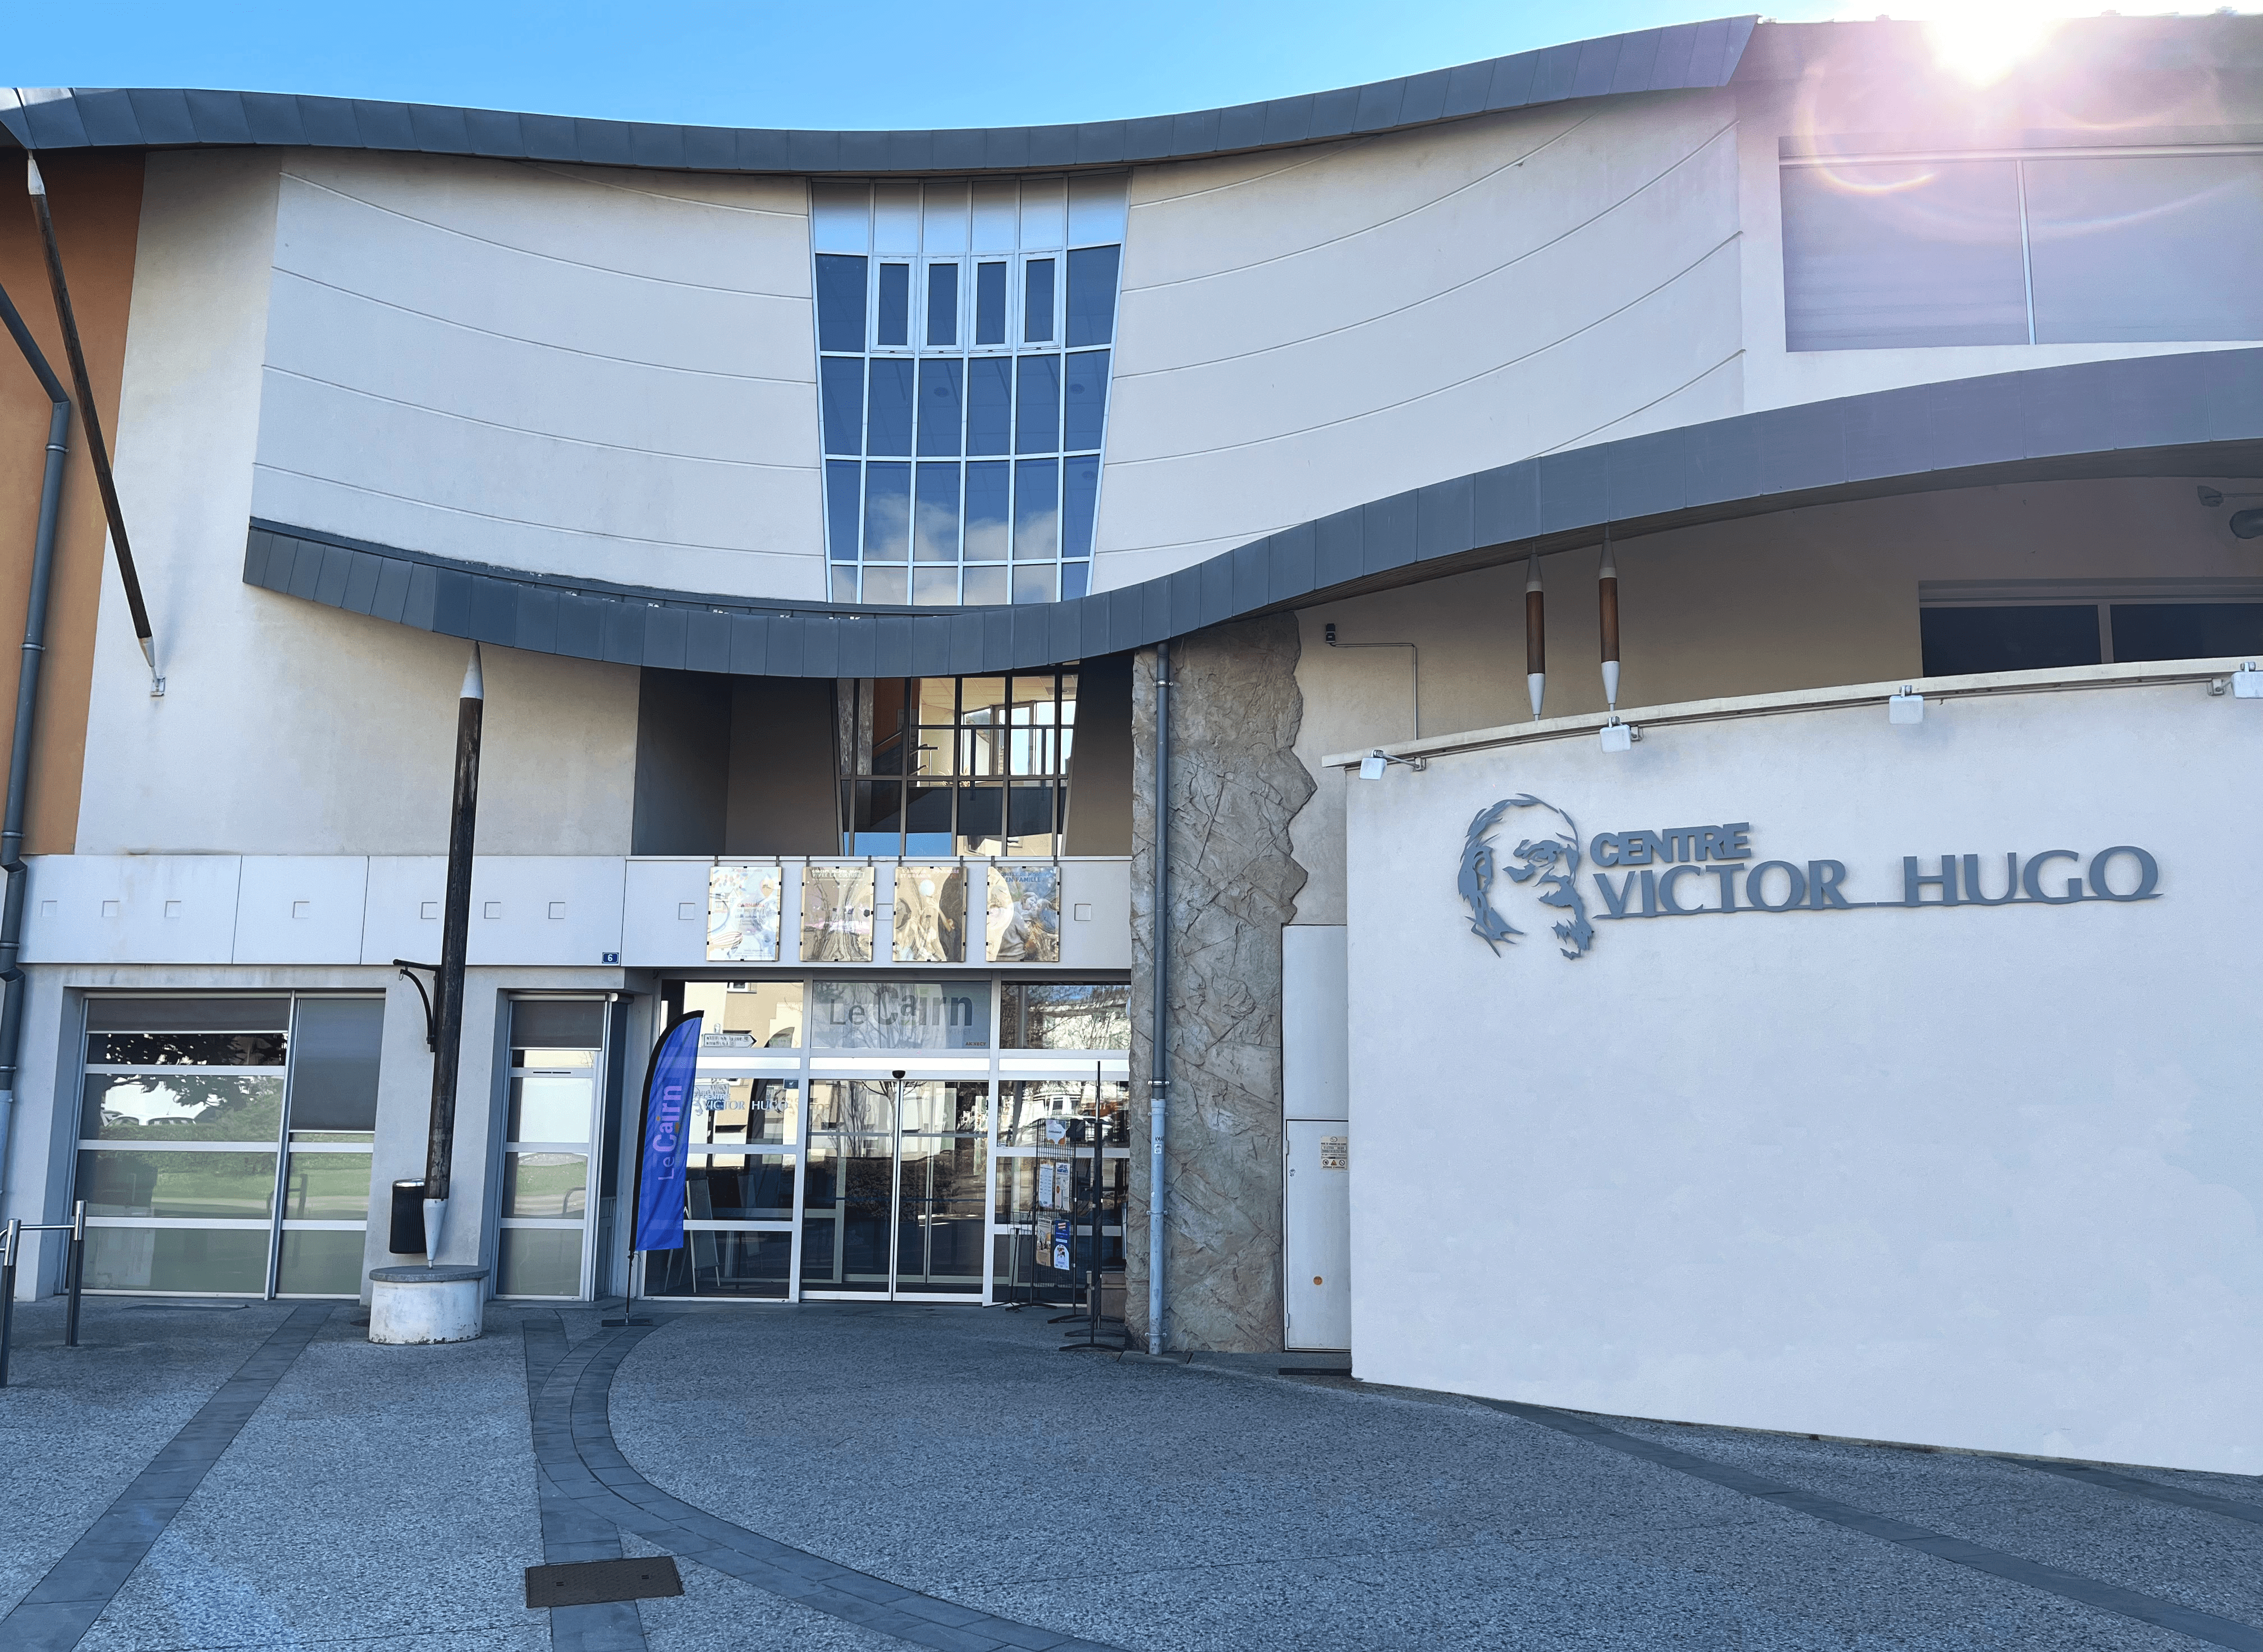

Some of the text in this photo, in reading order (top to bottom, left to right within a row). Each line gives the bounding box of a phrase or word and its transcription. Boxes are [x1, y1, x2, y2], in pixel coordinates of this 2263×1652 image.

[1590, 822, 1751, 866] CENTRE
[1592, 846, 2159, 919] VICTOR HUGO
[607, 953, 613, 962] 6
[830, 985, 973, 1026] Le Cairn
[703, 1100, 745, 1110] VICTOR
[653, 1085, 682, 1180] Le Cairn
